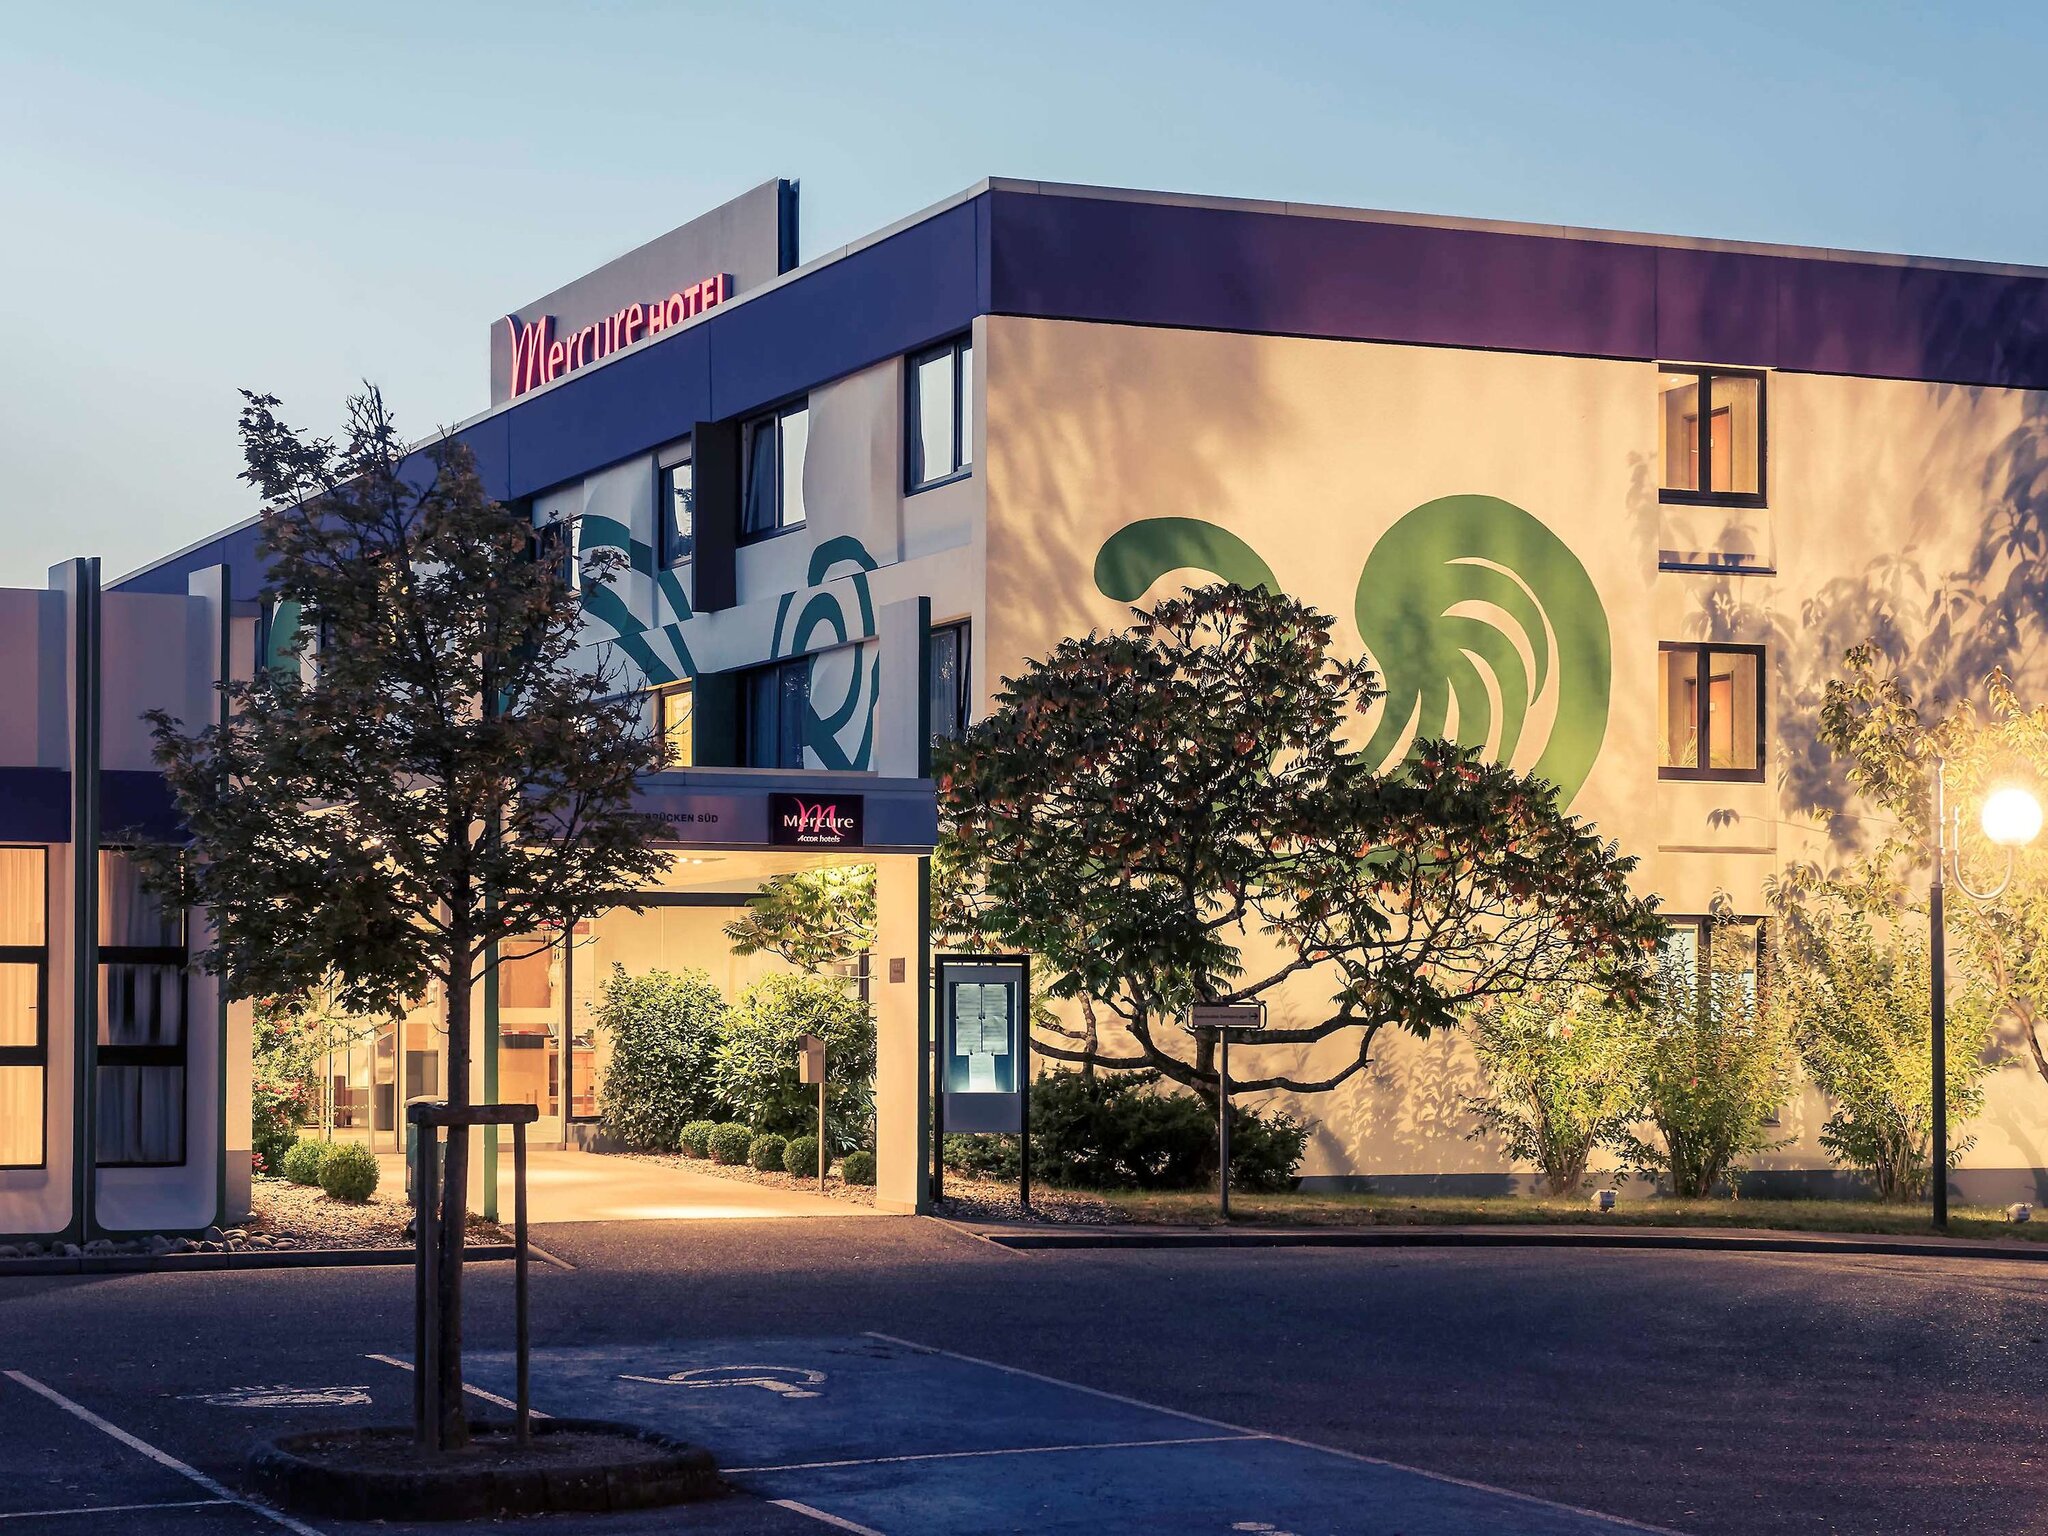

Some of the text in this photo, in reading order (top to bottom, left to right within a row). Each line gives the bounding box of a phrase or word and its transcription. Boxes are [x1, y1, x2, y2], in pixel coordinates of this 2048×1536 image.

[505, 302, 645, 399] Mercure
[698, 813, 719, 823] SÜD
[783, 814, 854, 830] Mercure
[819, 834, 841, 843] hotels
